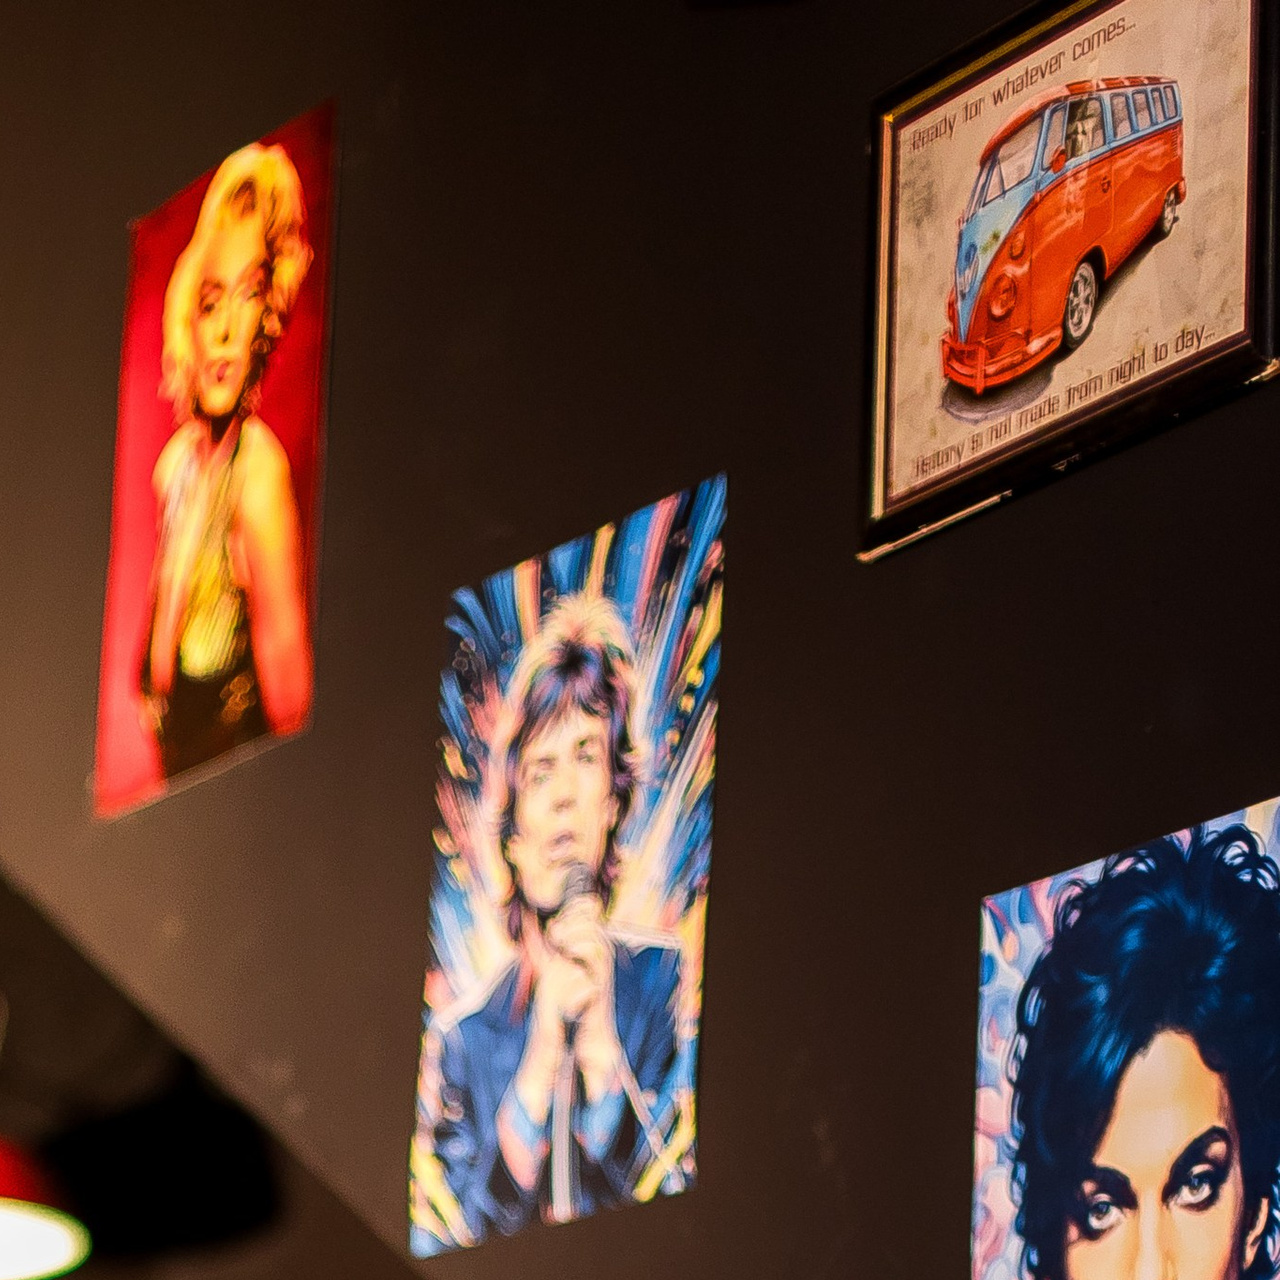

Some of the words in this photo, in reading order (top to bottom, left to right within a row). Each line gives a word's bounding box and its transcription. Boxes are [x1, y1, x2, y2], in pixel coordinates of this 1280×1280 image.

[910, 112, 957, 151] Ready
[963, 96, 985, 123] for
[992, 51, 1065, 106] whatever
[1072, 16, 1136, 62] comes...
[1017, 394, 1060, 429] made
[1065, 373, 1103, 408] from
[1108, 347, 1146, 386] night
[1153, 341, 1168, 364] to
